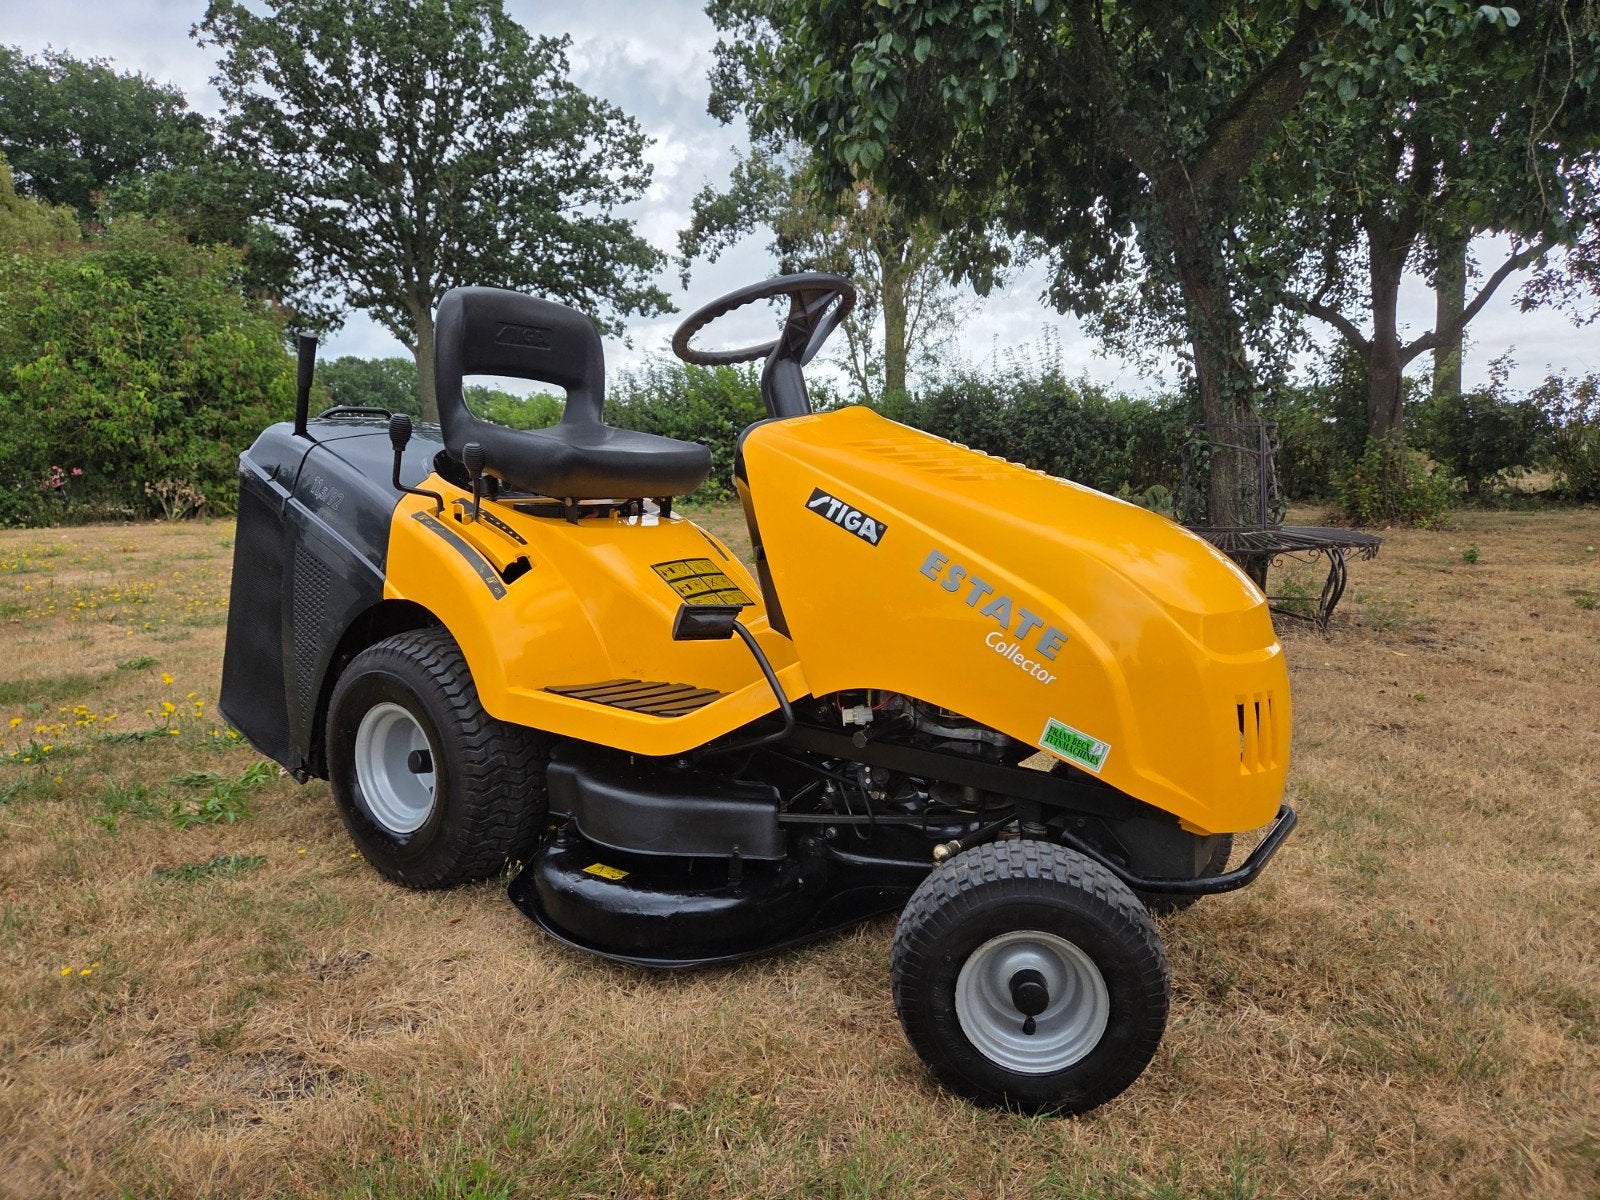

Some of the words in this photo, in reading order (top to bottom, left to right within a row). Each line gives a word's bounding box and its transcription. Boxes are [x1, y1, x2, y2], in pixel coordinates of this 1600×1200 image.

[808, 495, 878, 544] STIGA
[919, 548, 1069, 662] ESTATE
[985, 631, 1057, 685] Collector
[1045, 733, 1099, 765] TUINMACHINES
[1048, 726, 1071, 742] FRANS
